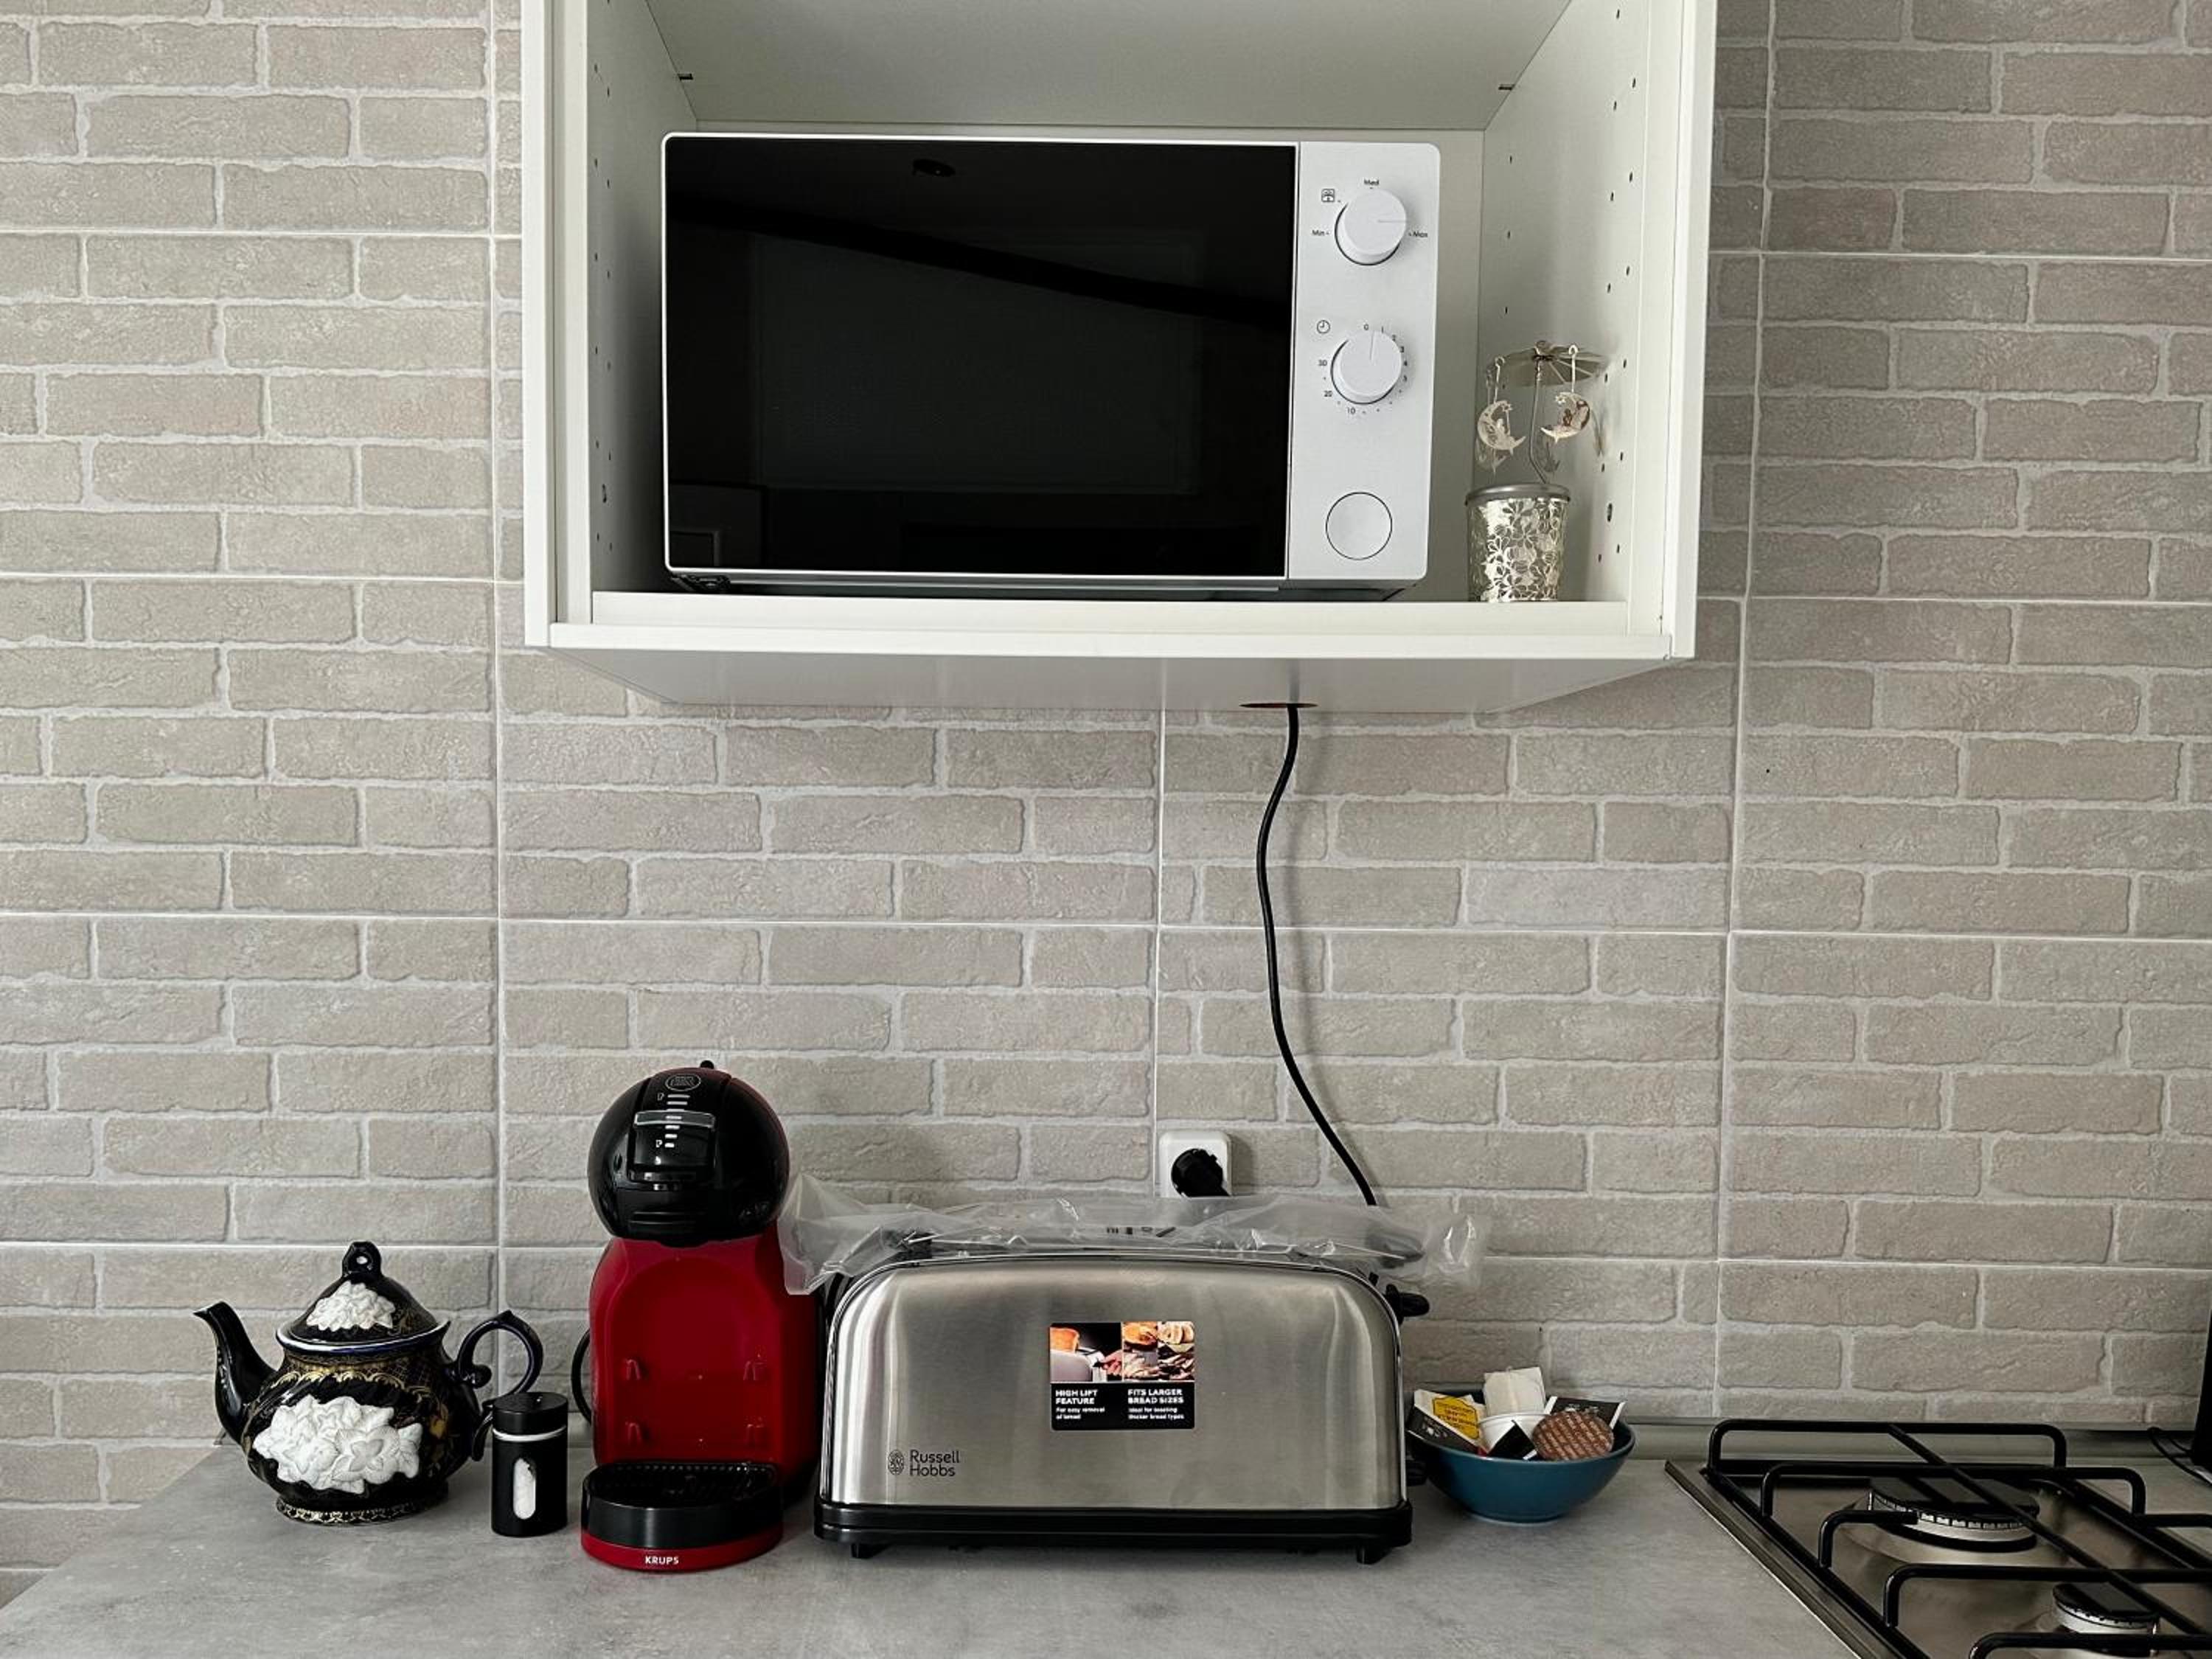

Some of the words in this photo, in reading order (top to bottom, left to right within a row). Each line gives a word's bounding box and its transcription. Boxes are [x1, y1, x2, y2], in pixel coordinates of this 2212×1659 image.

[1346, 406, 1356, 414] 10
[1055, 1389, 1079, 1397] HIGH
[1079, 1389, 1098, 1397] LIFT
[1127, 1397, 1158, 1405] BREAD
[909, 1450, 959, 1464] Russell
[909, 1464, 956, 1477] Hobbs
[645, 1555, 679, 1565] KRUPS
